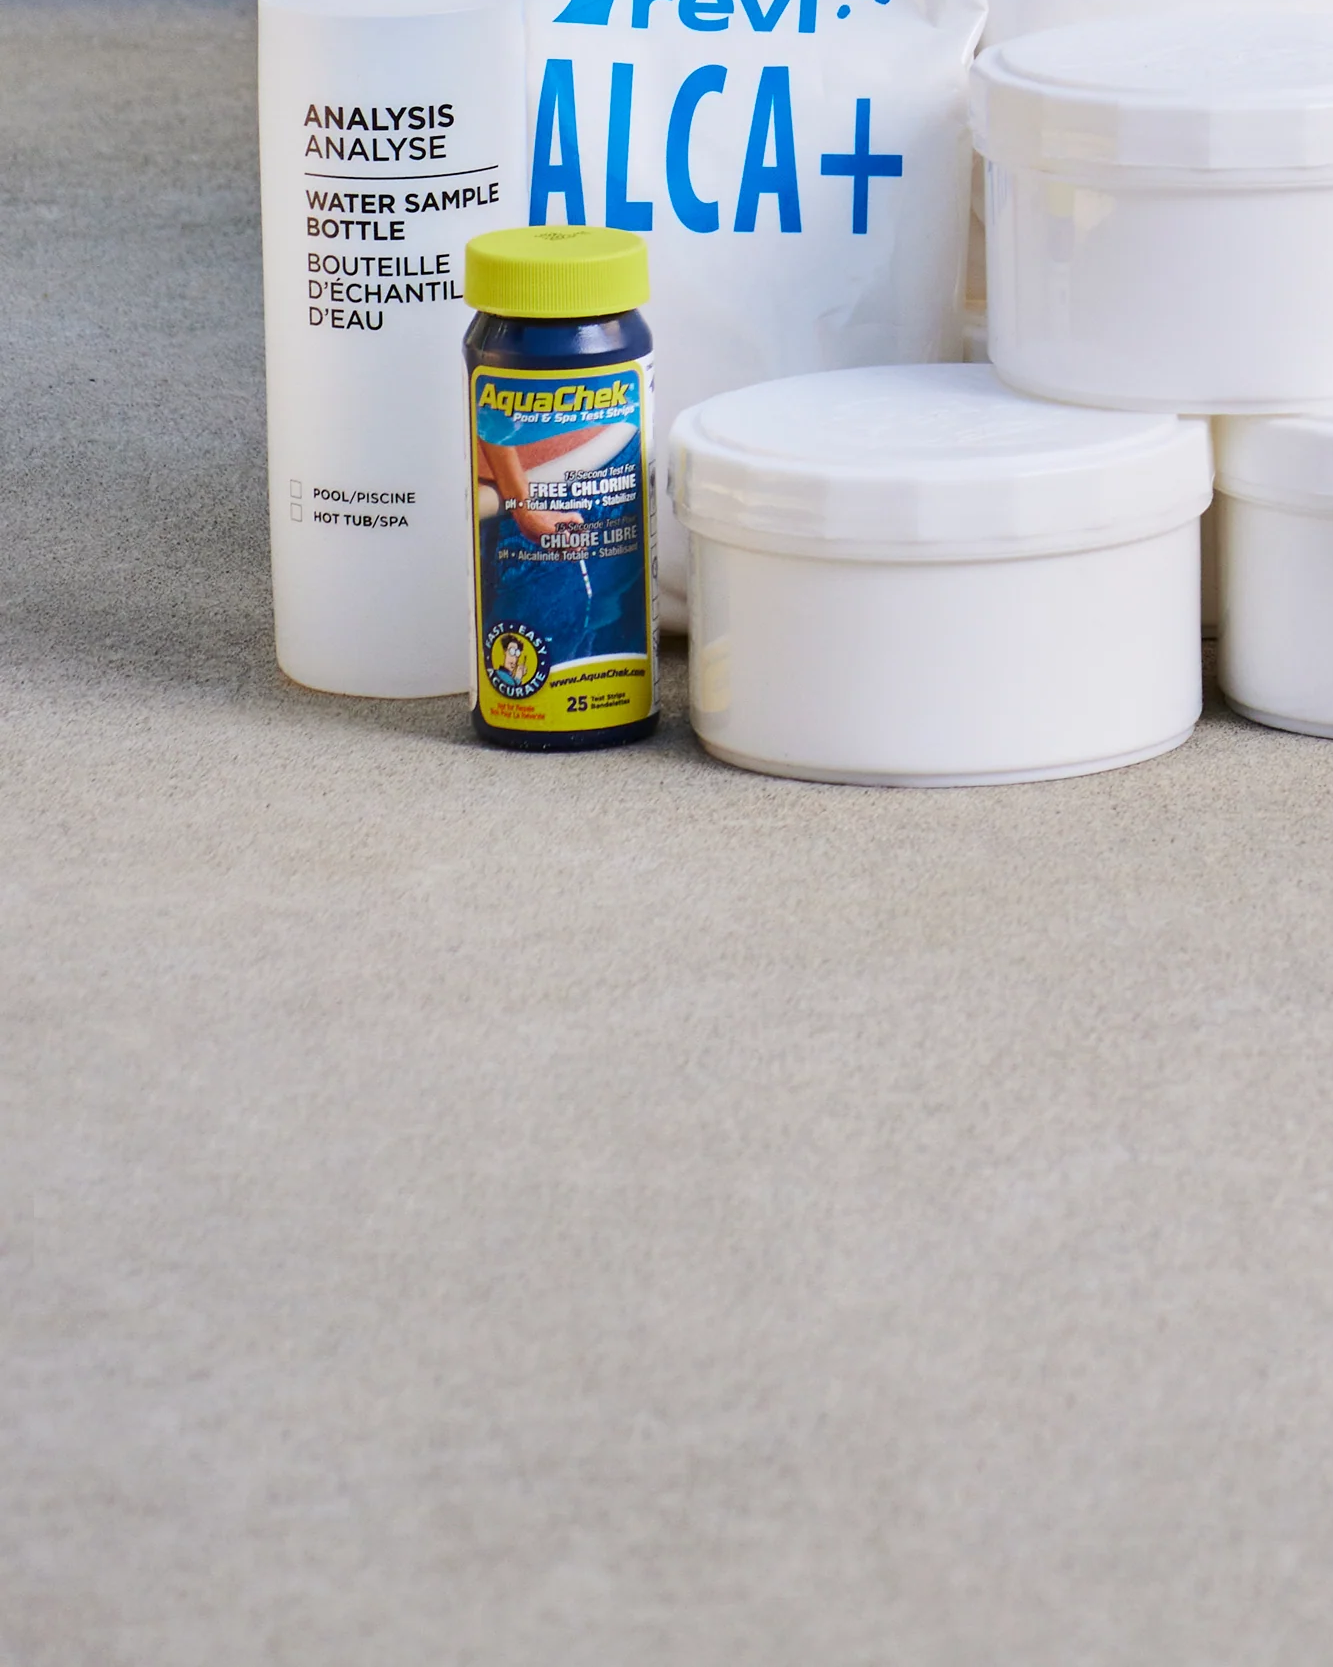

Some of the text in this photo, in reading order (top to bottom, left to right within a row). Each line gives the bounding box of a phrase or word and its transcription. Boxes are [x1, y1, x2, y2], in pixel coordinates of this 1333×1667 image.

[304, 104, 454, 131] ANALYSIS
[305, 134, 446, 162] ANALYSE
[529, 57, 904, 234] ALCA+
[306, 182, 499, 214] WATER SAMPLE
[307, 216, 405, 240] BOTTLE
[308, 253, 450, 276] BOUTEILLE
[309, 278, 463, 303] D'ÉCHANTIL
[309, 306, 383, 330] D'EAU
[479, 380, 630, 416] AquaChek
[513, 406, 635, 424] Pool & Spa Test Strips
[314, 488, 416, 504] POOL/PISCINE
[529, 474, 636, 497] FREE CHLORINE
[314, 511, 408, 528] HOT TUB/SPA
[541, 525, 636, 548] CHLORE LIBRE
[486, 623, 547, 656] FAST EASY
[487, 668, 545, 697] ACCURATE
[567, 696, 588, 712] 25
